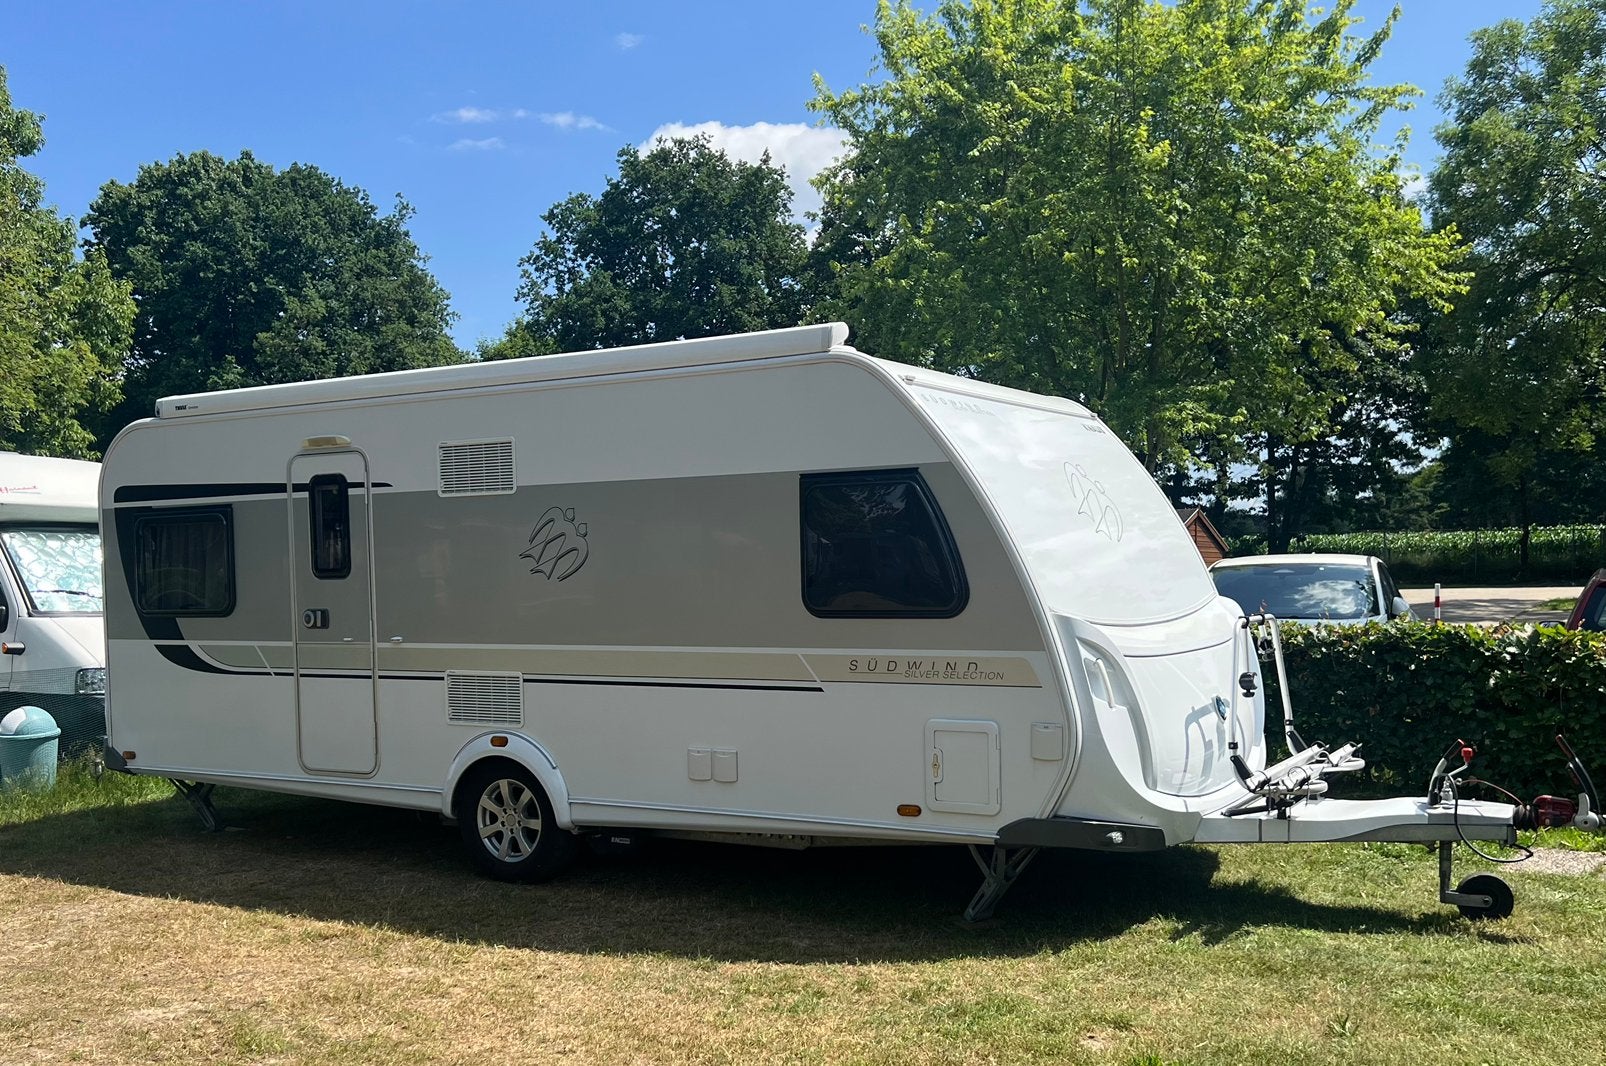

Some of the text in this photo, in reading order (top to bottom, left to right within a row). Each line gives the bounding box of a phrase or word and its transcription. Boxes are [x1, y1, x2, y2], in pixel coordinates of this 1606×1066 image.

[848, 657, 979, 672] SÜDWIND
[904, 670, 1005, 680] SILVER SELECTION
